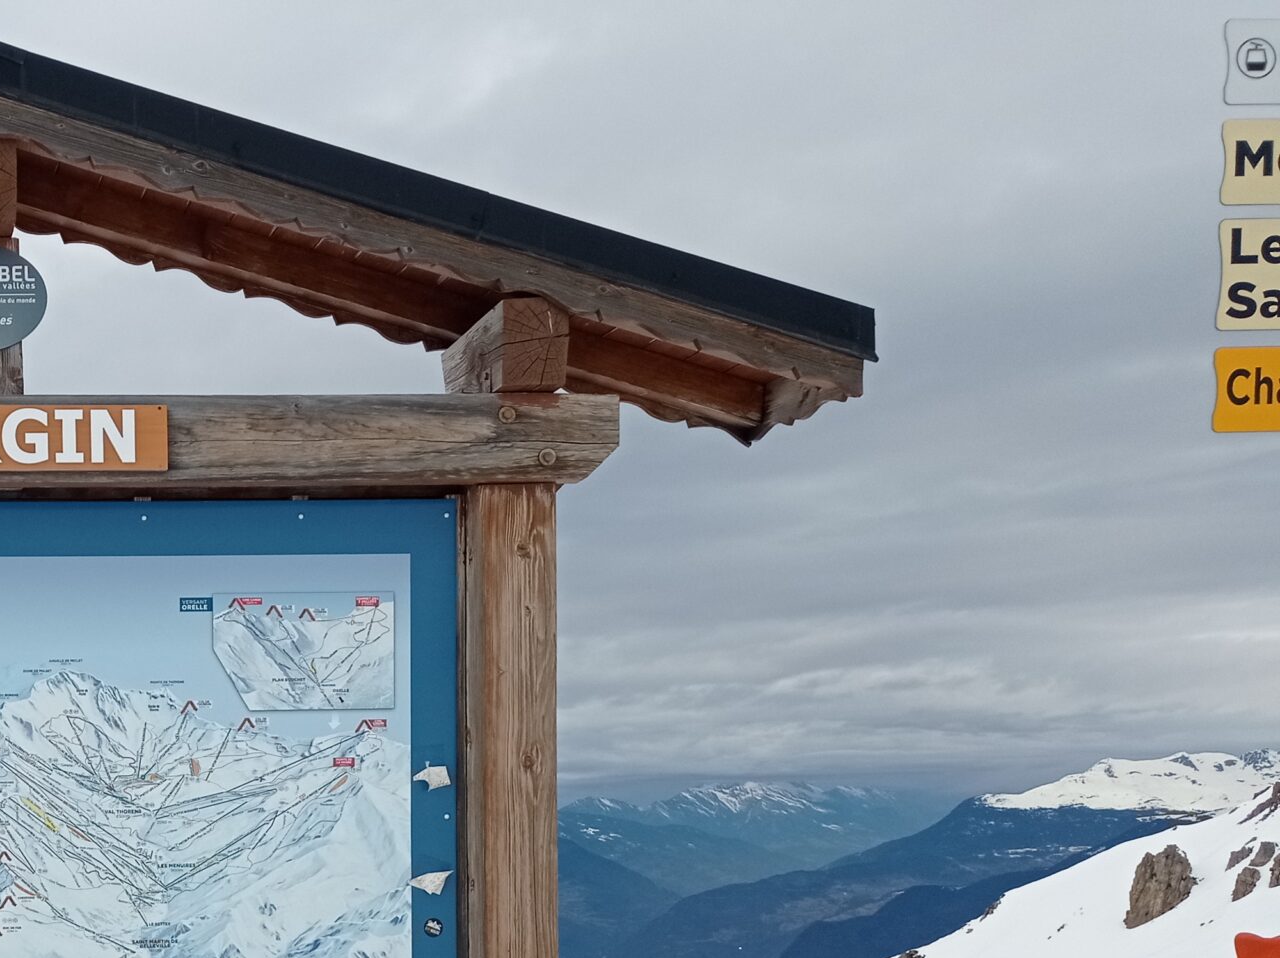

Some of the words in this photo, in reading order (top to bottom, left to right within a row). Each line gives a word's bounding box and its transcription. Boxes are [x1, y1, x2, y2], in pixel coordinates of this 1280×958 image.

[1235, 140, 1280, 176] M
[1230, 228, 1280, 264] Le
[2, 282, 36, 290] vallées
[1226, 367, 1280, 405] Ch
